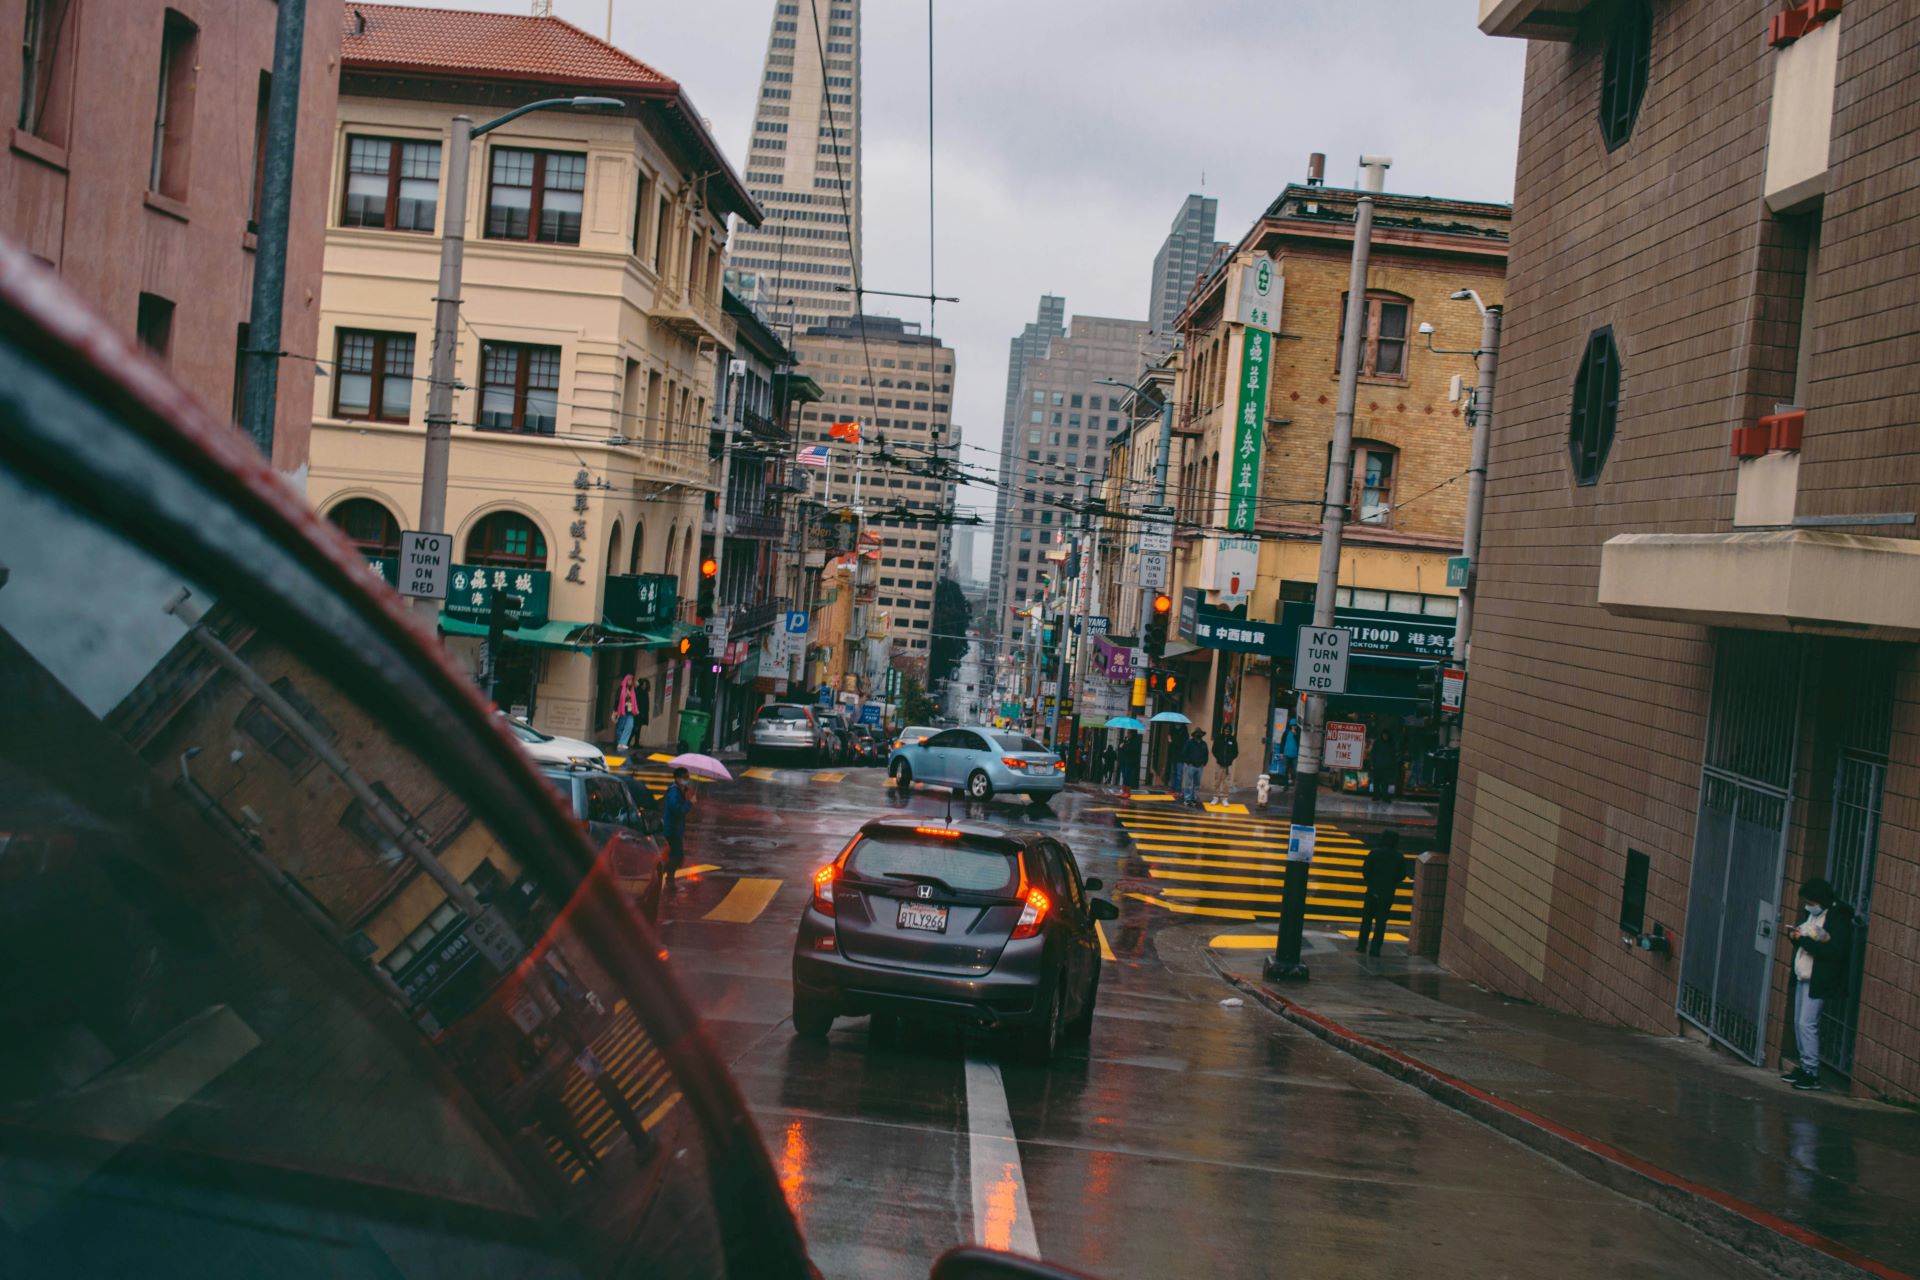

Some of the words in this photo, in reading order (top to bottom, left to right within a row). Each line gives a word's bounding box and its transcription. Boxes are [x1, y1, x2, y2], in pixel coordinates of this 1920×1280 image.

[415, 537, 440, 551] NO
[1219, 539, 1238, 551] APPLE
[1241, 540, 1257, 554] LAND
[410, 553, 441, 566] TURN
[1147, 557, 1161, 565] NO
[415, 568, 433, 579] ON
[1451, 565, 1464, 584] Clay
[411, 582, 434, 593] RED
[1312, 631, 1338, 646] NO
[1362, 628, 1399, 643] FOOD
[1349, 641, 1379, 649] OCKTON
[1308, 648, 1338, 660] TURN
[1313, 663, 1330, 674] ON
[1309, 676, 1332, 689] RED
[1330, 723, 1362, 732] TOW-AWAY
[1326, 729, 1337, 740] NO
[1338, 732, 1362, 742] STOPPING
[1337, 742, 1351, 750] ANY
[1335, 750, 1352, 759] TIME
